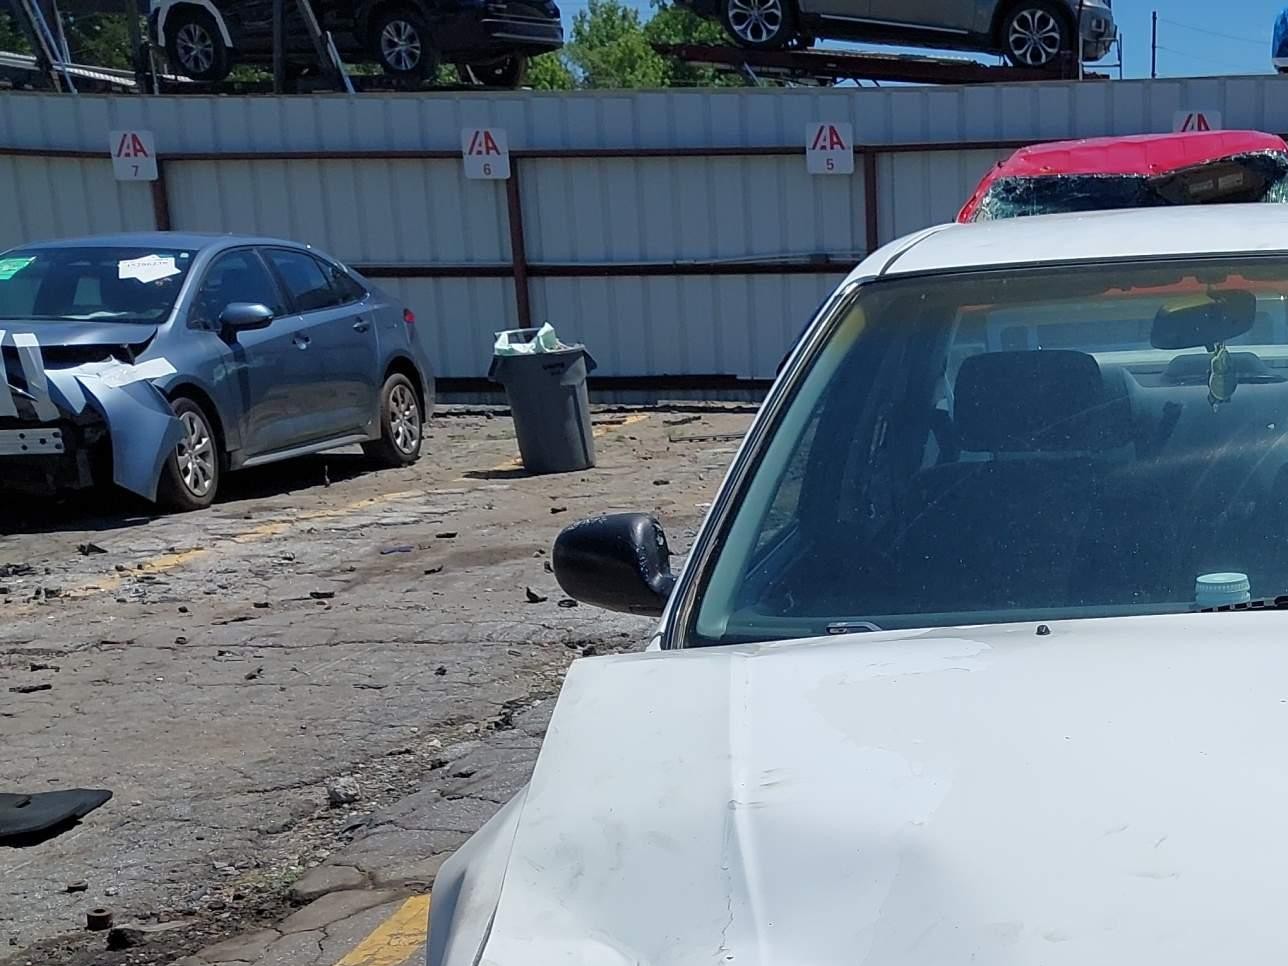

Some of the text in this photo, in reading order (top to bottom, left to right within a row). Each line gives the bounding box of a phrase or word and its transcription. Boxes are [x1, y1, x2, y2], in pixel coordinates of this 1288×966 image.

[131, 164, 139, 177] 7
[483, 163, 492, 176] 6
[826, 158, 835, 170] 5
